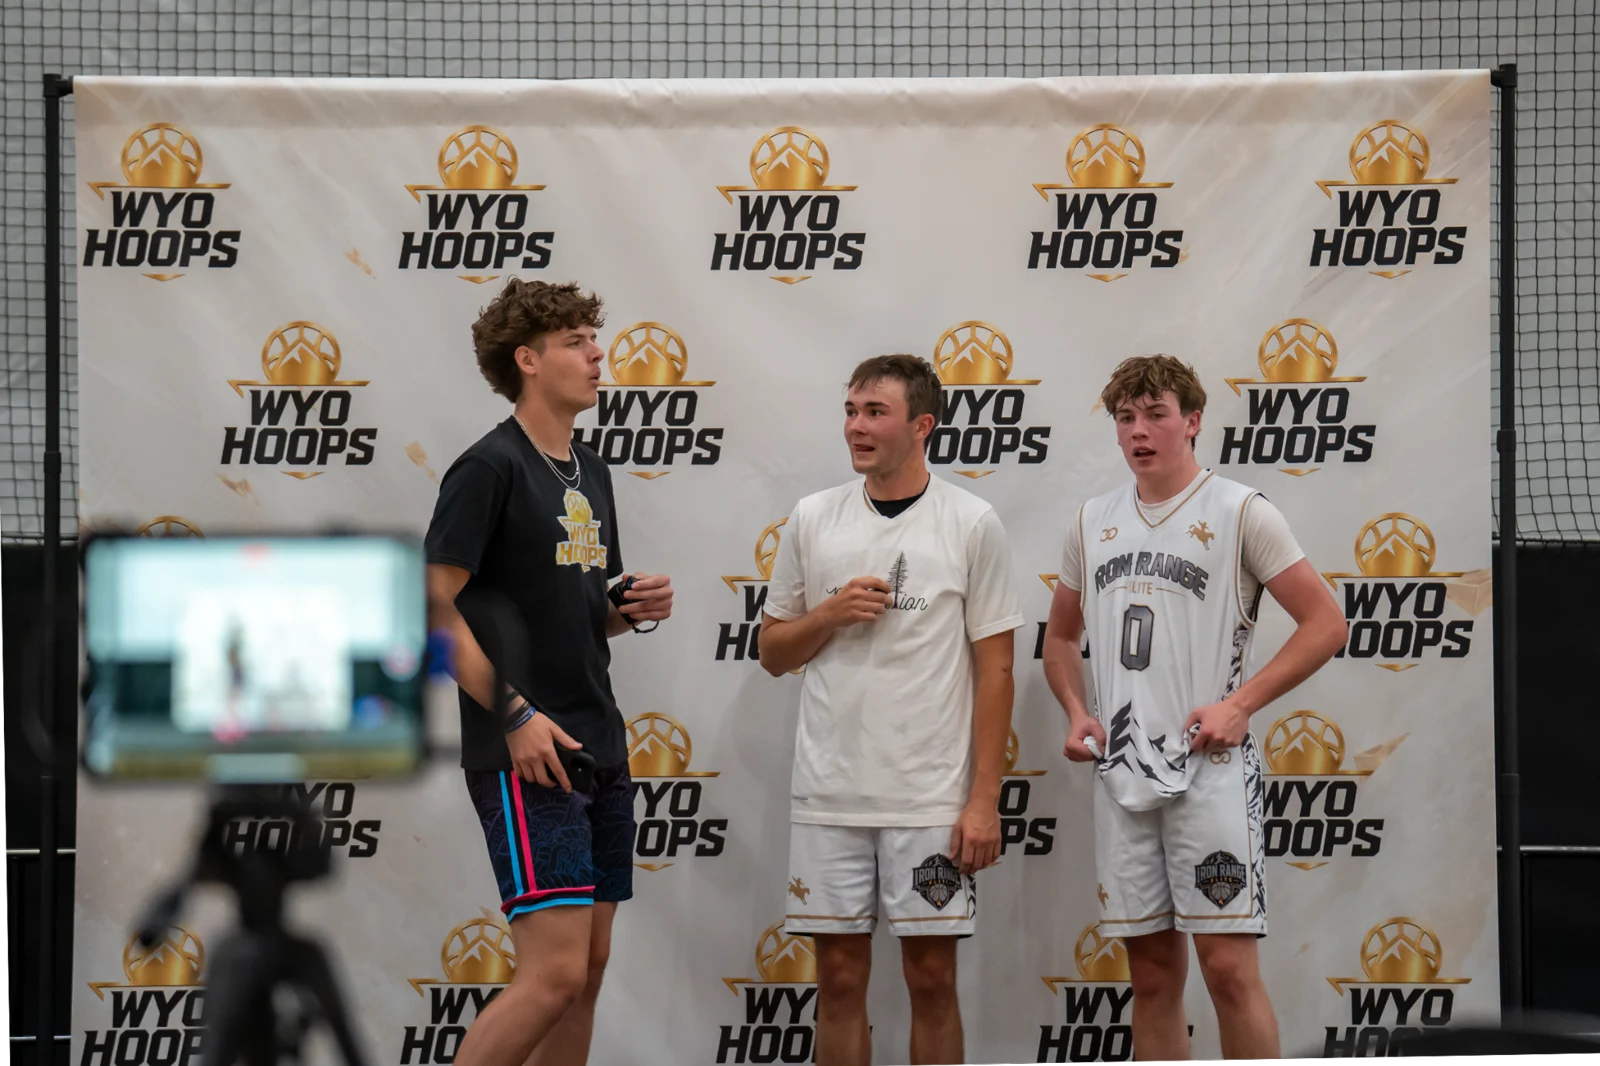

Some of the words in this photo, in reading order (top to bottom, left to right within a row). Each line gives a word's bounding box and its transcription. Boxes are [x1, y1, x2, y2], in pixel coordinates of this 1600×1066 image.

[111, 192, 214, 228] WYO
[427, 194, 528, 230] WYO
[739, 196, 839, 231] WYO
[1056, 193, 1157, 229] WYO
[1338, 189, 1441, 227] WYO
[83, 229, 240, 267] HOOPS
[399, 232, 554, 269] HOOPS
[711, 233, 865, 270] HOOPS
[1028, 231, 1183, 268] HOOPS
[1310, 227, 1467, 266] HOOPS
[250, 390, 351, 426] WYO
[597, 390, 698, 426] WYO
[1248, 388, 1349, 425] WYO
[221, 427, 377, 465] HOOPS
[928, 427, 1051, 464] OOPS
[1220, 425, 1376, 464] HOOPS
[569, 523, 598, 546] WYO
[559, 543, 606, 567] HOOPS
[1095, 552, 1133, 597] RON
[1134, 551, 1209, 601] RANGE
[1343, 583, 1447, 619] WYO
[1121, 604, 1154, 672] 0
[290, 782, 356, 818] YO
[632, 781, 702, 817] YO
[1262, 780, 1357, 817] WYO
[633, 819, 728, 857] OPS
[1263, 819, 1384, 857] OOPS
[914, 867, 936, 886] IRON
[1197, 865, 1218, 883] IRON
[1219, 864, 1246, 883] RANGE
[430, 988, 504, 1024] WY
[744, 987, 818, 1024] WY
[1065, 987, 1134, 1024] WY
[1349, 988, 1454, 1026] WYO
[80, 1029, 205, 1066] HOOP
[716, 1025, 872, 1064] HOO
[1036, 1025, 1194, 1064] HOO
